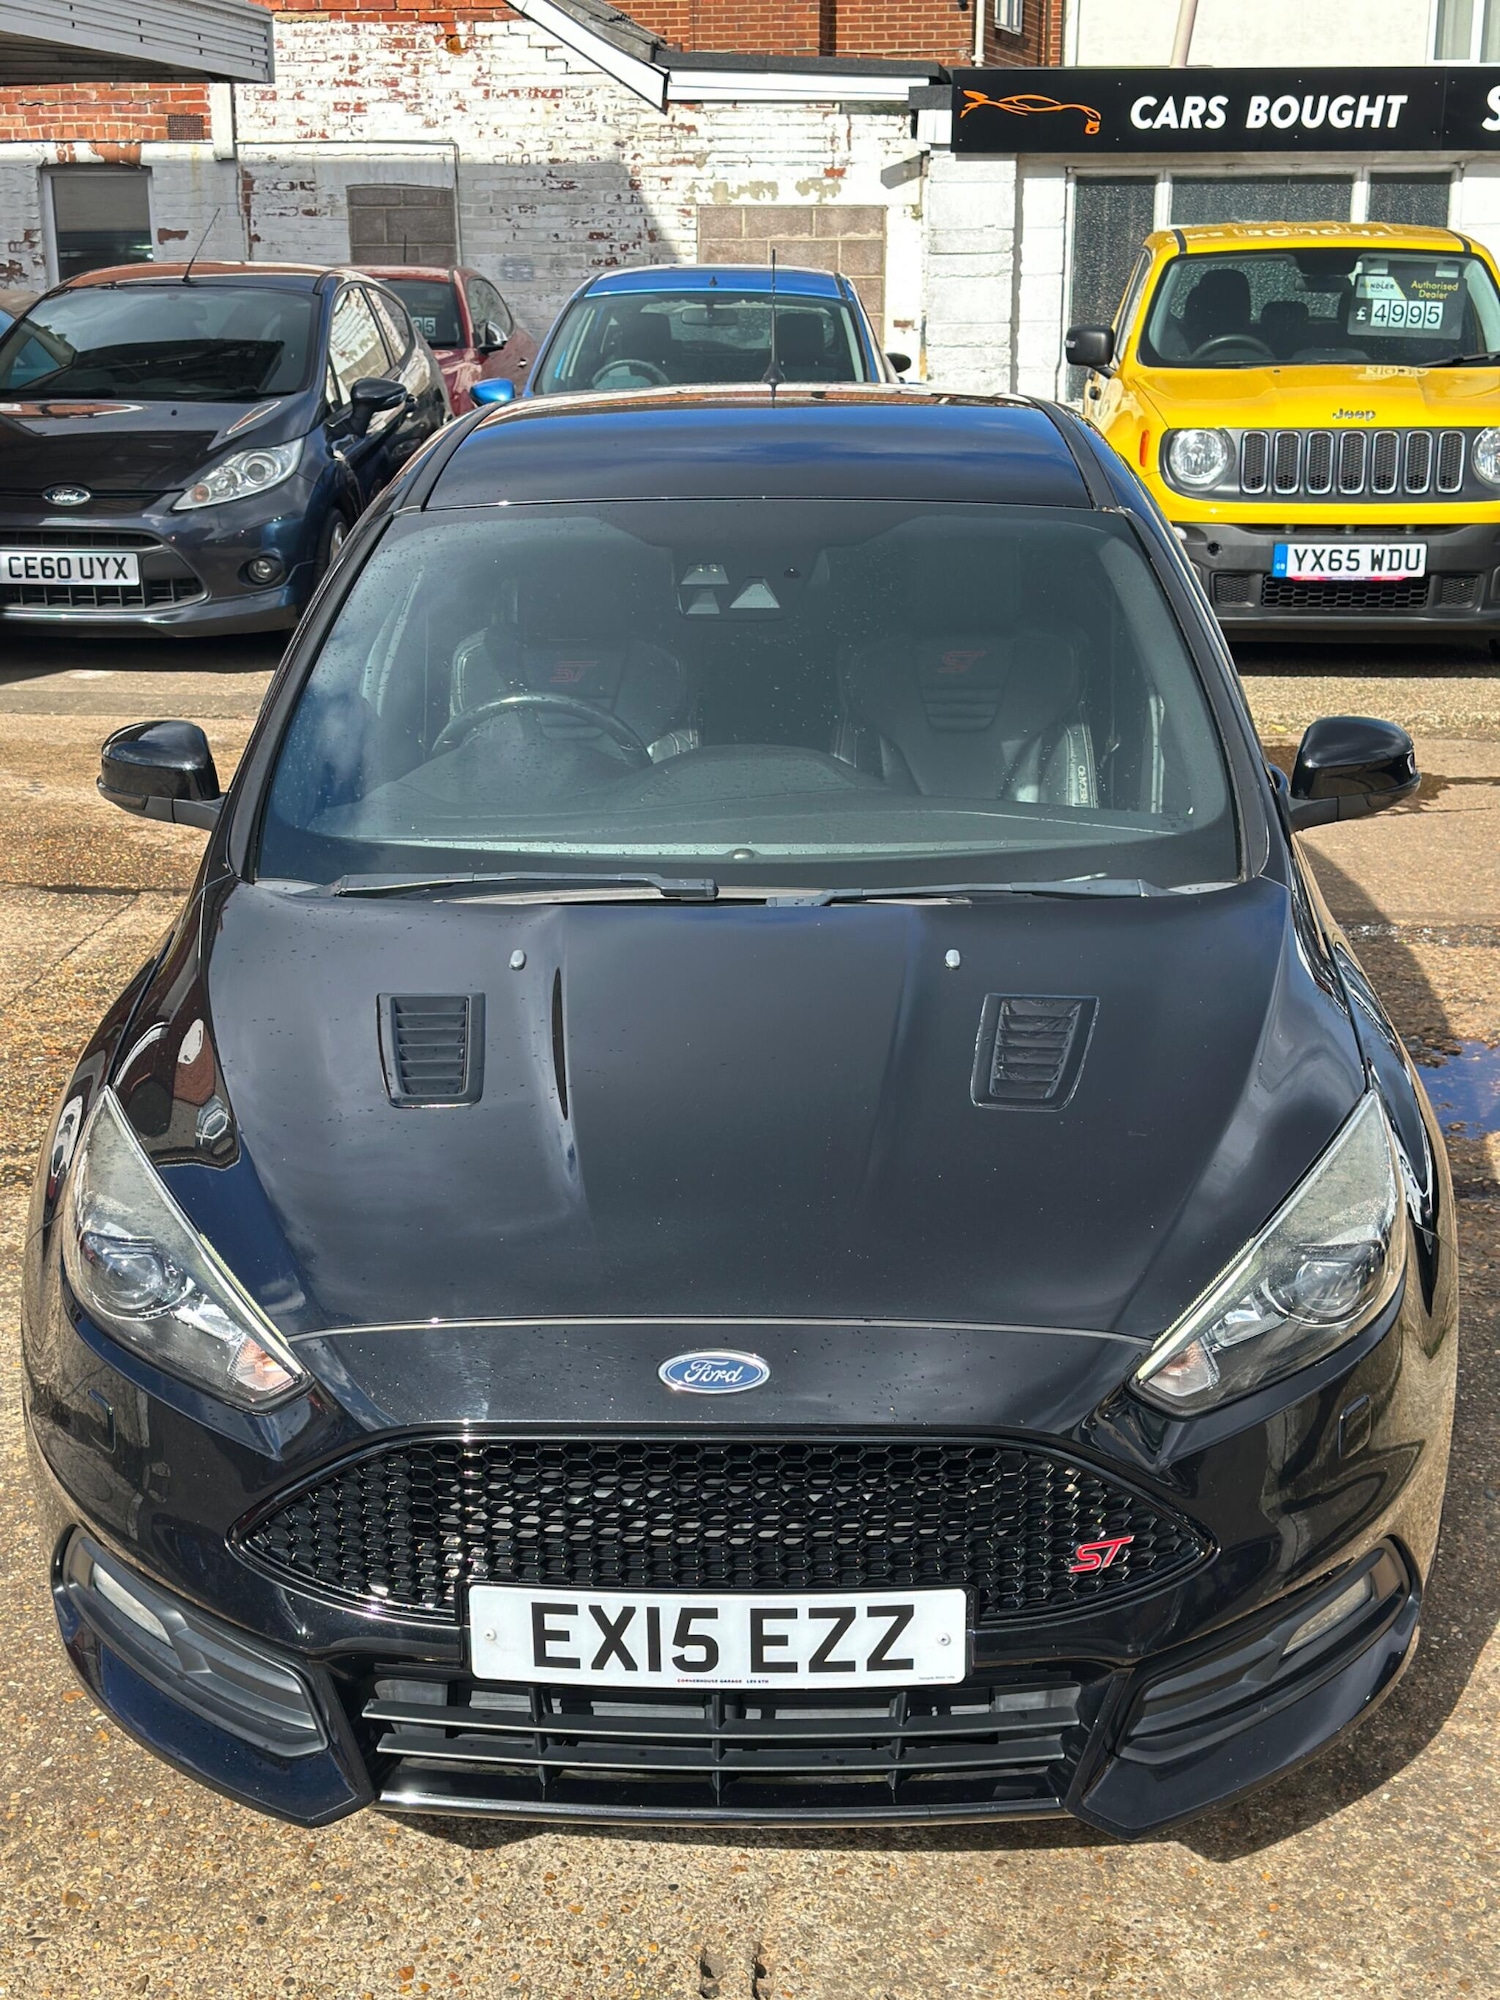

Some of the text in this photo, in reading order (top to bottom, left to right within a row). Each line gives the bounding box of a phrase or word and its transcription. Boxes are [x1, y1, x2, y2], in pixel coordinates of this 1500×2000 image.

[1130, 94, 1408, 130] CARS BOUGHT
[1411, 280, 1459, 292] Authorised
[1418, 289, 1448, 299] Dealer
[1332, 408, 1377, 421] Jeep
[8, 556, 129, 580] CE60 UYX
[1294, 548, 1421, 572] YX65 WDU
[1078, 765, 1089, 804] RECARO
[683, 1359, 744, 1383] Ford
[1068, 1535, 1135, 1573] ST
[531, 1602, 914, 1673] EX15 EZZ
